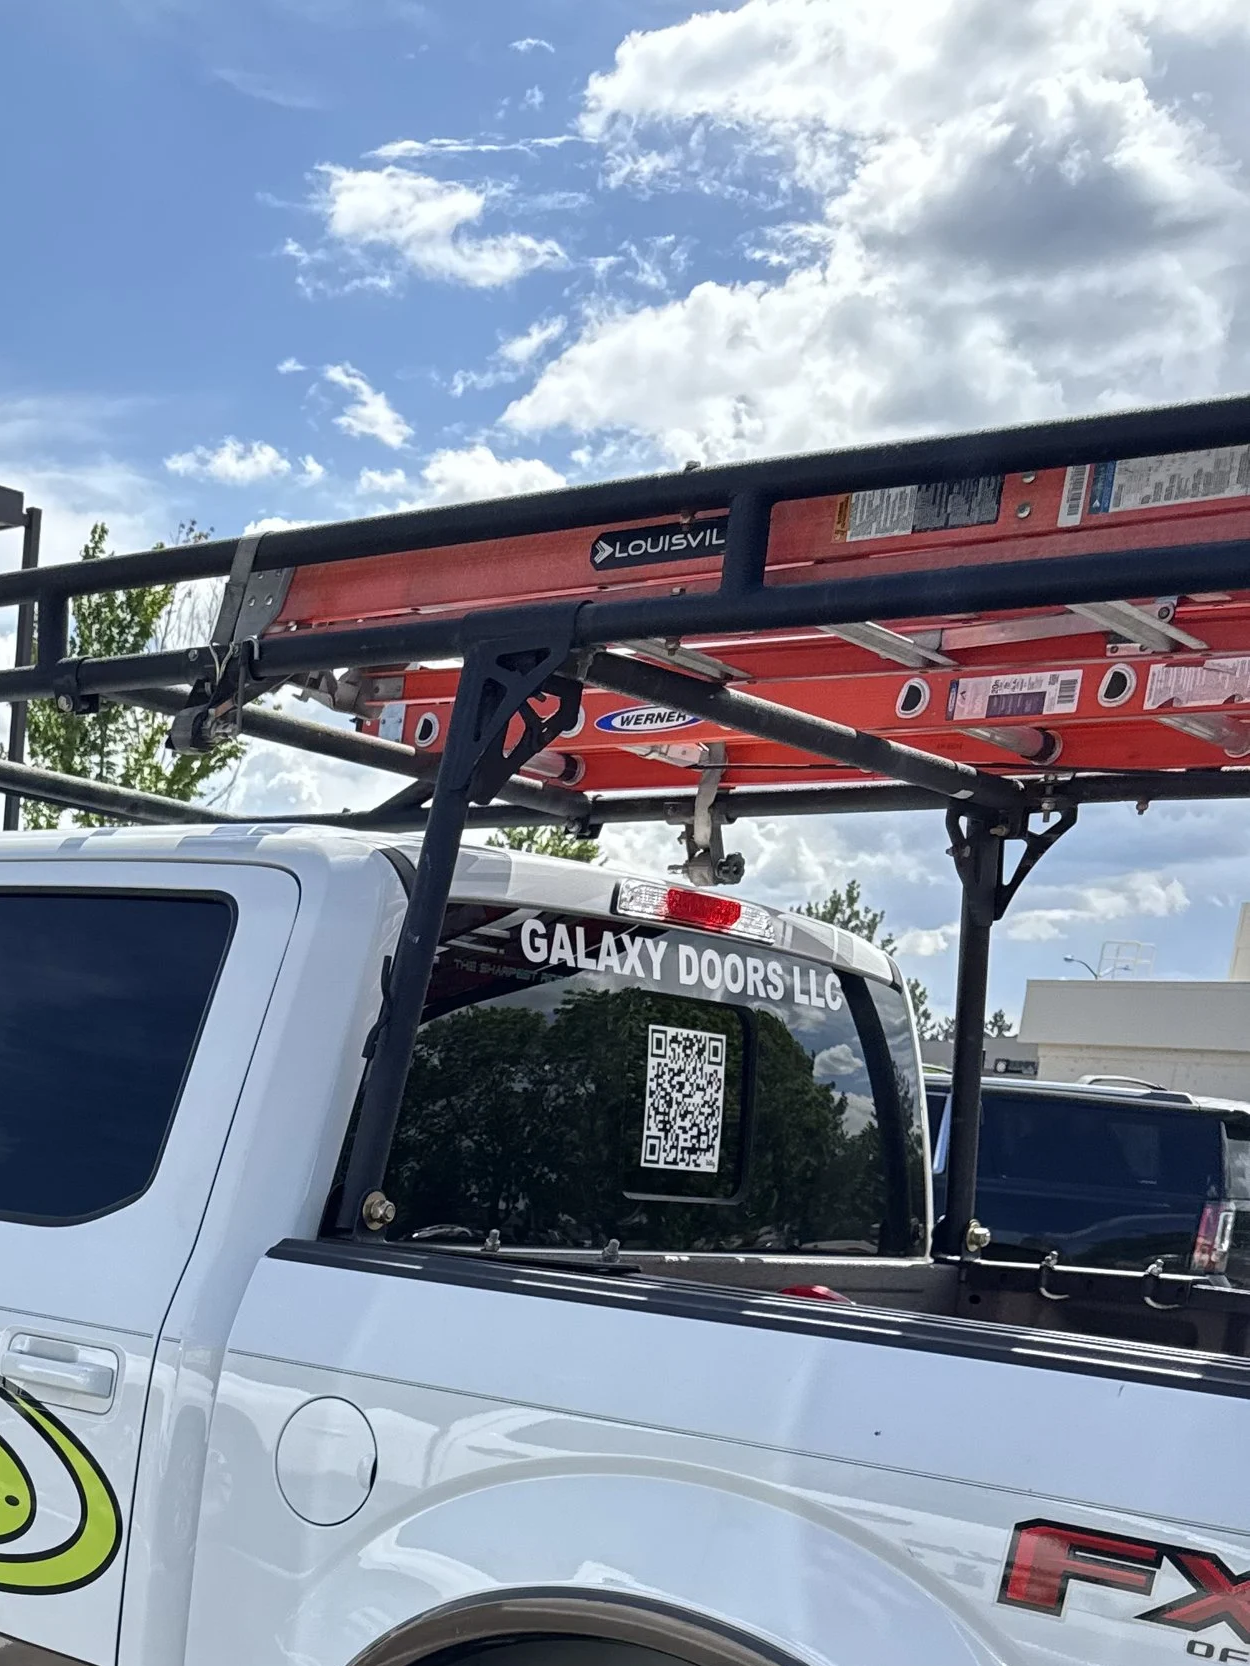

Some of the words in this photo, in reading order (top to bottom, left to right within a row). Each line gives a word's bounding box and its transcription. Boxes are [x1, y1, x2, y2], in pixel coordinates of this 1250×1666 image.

[614, 527, 726, 558] LOUISVIL
[619, 711, 687, 727] WERNER
[520, 918, 668, 981] GALAXY
[678, 944, 785, 1001] DOORS
[793, 966, 843, 1011] LLC
[1186, 1640, 1250, 1662] OF
